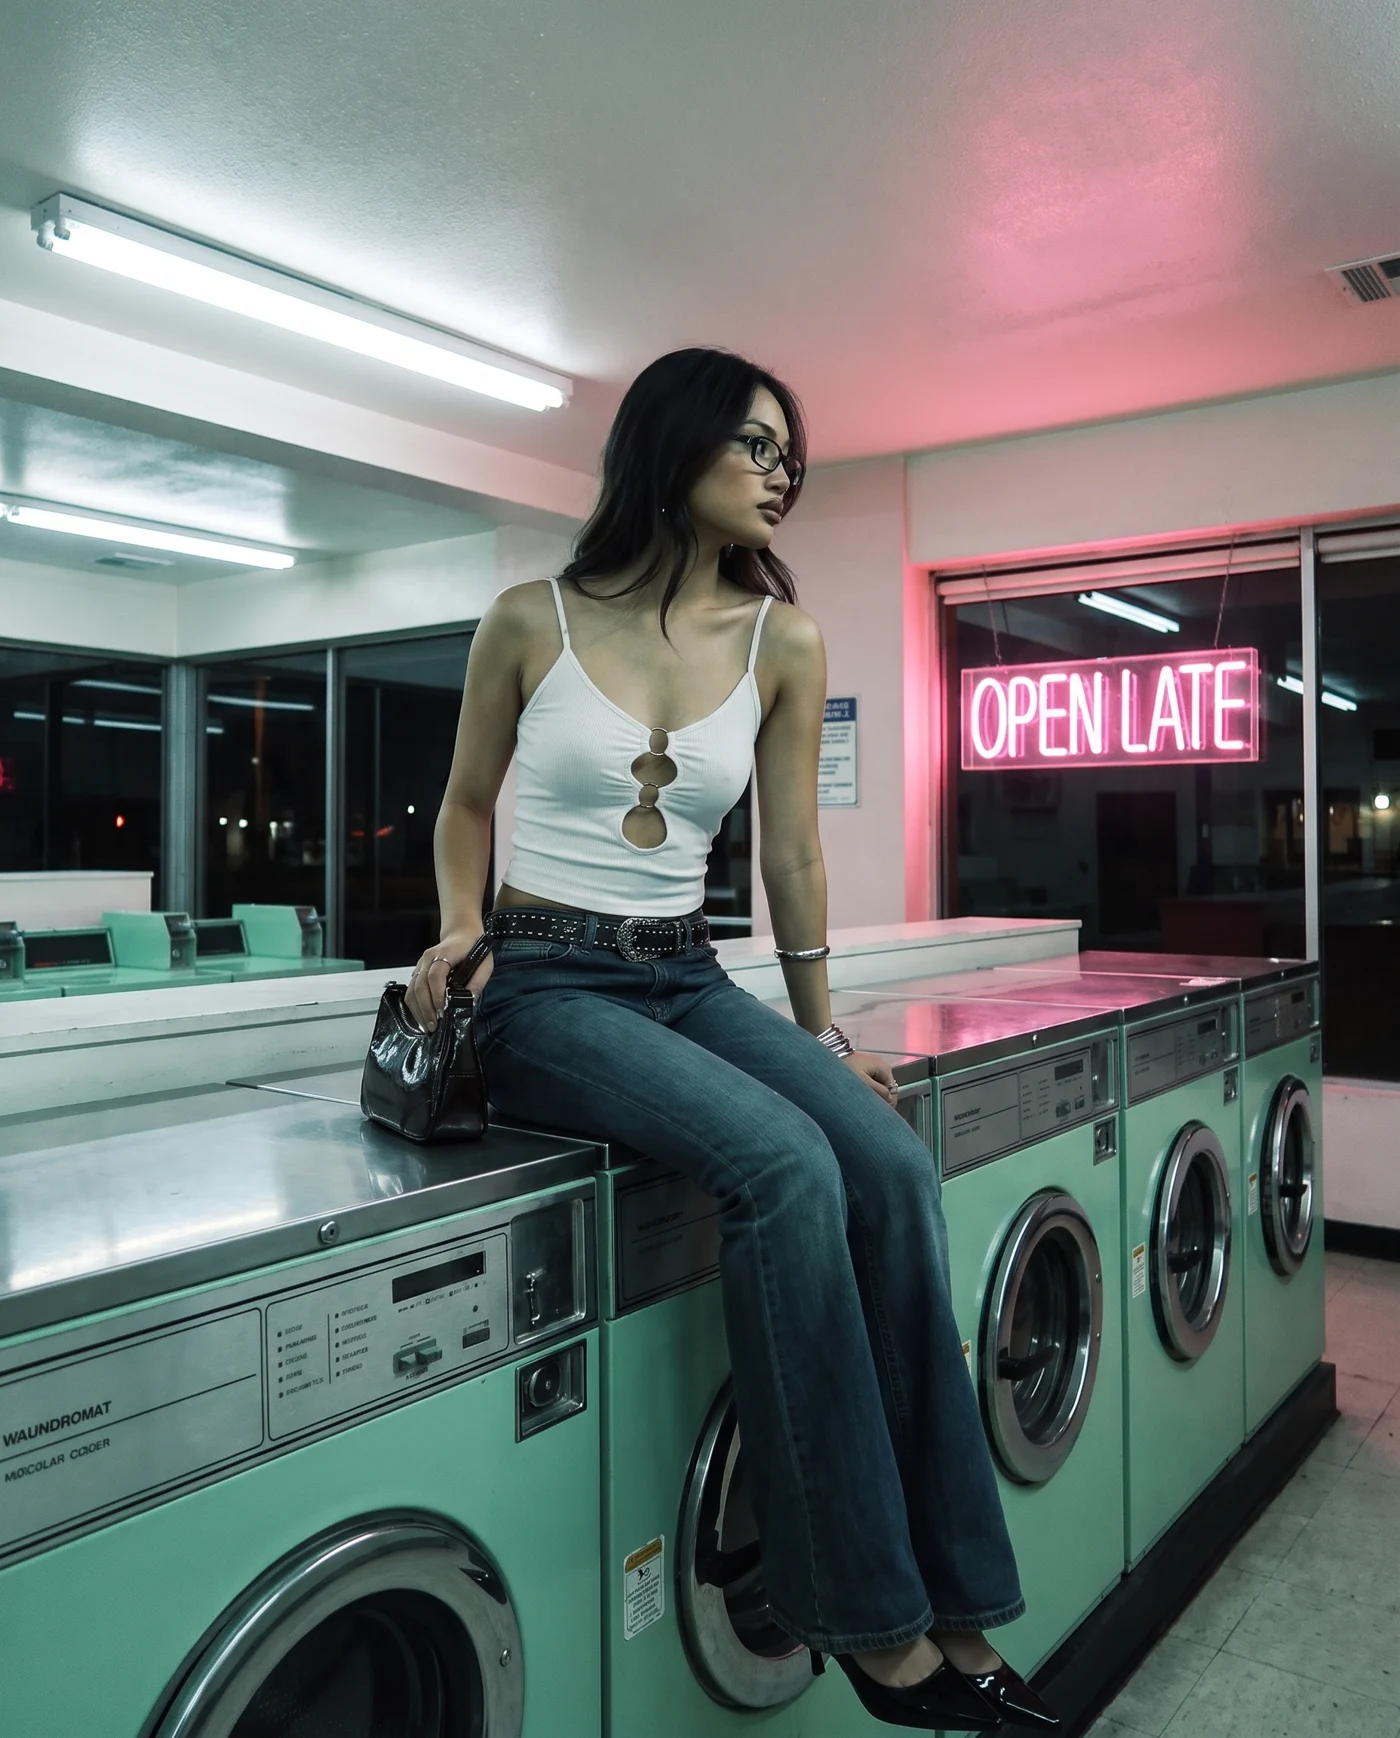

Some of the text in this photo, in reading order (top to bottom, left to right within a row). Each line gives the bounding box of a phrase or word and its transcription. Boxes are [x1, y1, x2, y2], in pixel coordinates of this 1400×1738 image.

[971, 661, 1247, 759] OPEN LATE
[3, 1400, 112, 1447] WAUNDROMAT
